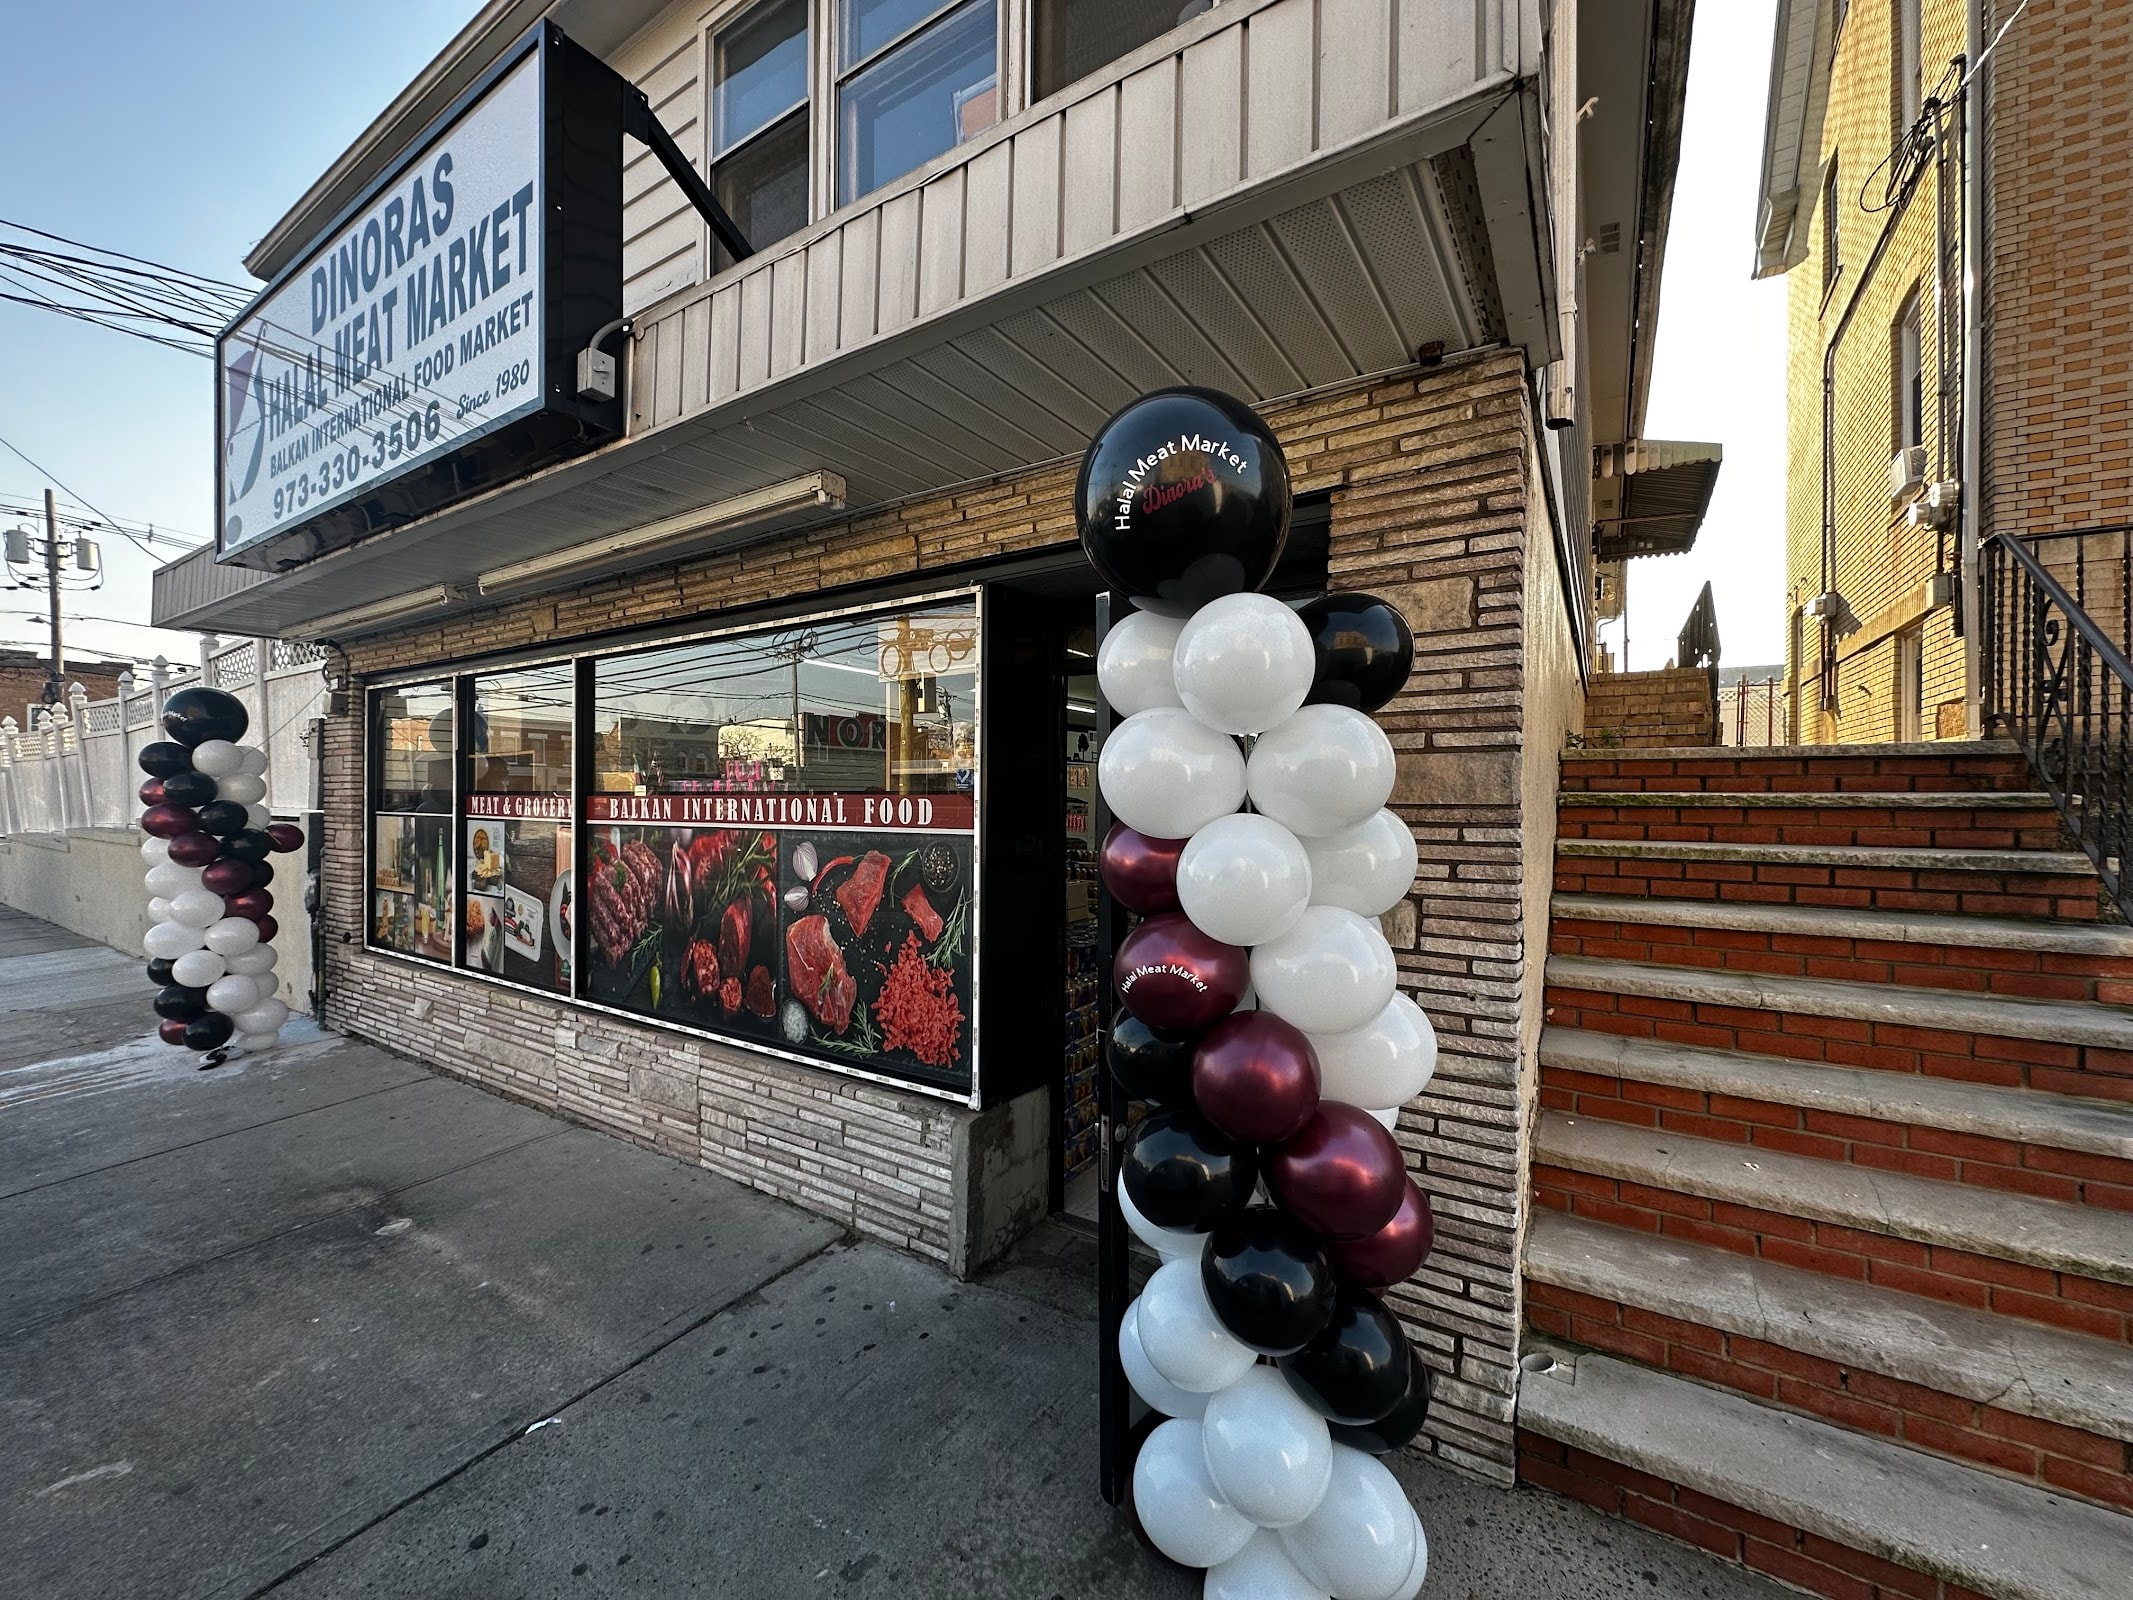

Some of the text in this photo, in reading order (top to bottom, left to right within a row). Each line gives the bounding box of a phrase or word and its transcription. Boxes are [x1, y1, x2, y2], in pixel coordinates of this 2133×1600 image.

[311, 152, 453, 337] DINORAS
[269, 180, 534, 442] HALAL MEAT MARKET
[270, 290, 533, 479] BALKAN INTERNATIONAL FOOD MARKET
[456, 358, 530, 420] Since 1980
[273, 399, 441, 520] 973-330-3506
[1114, 433, 1248, 531] Halal Meat Market
[1142, 466, 1217, 515] Dinora's
[471, 796, 500, 815] MEAT
[502, 796, 512, 816] &
[609, 797, 933, 825] BALKAN INTERNATIONAL FOOD
[1121, 964, 1208, 993] Halal Meat Market
